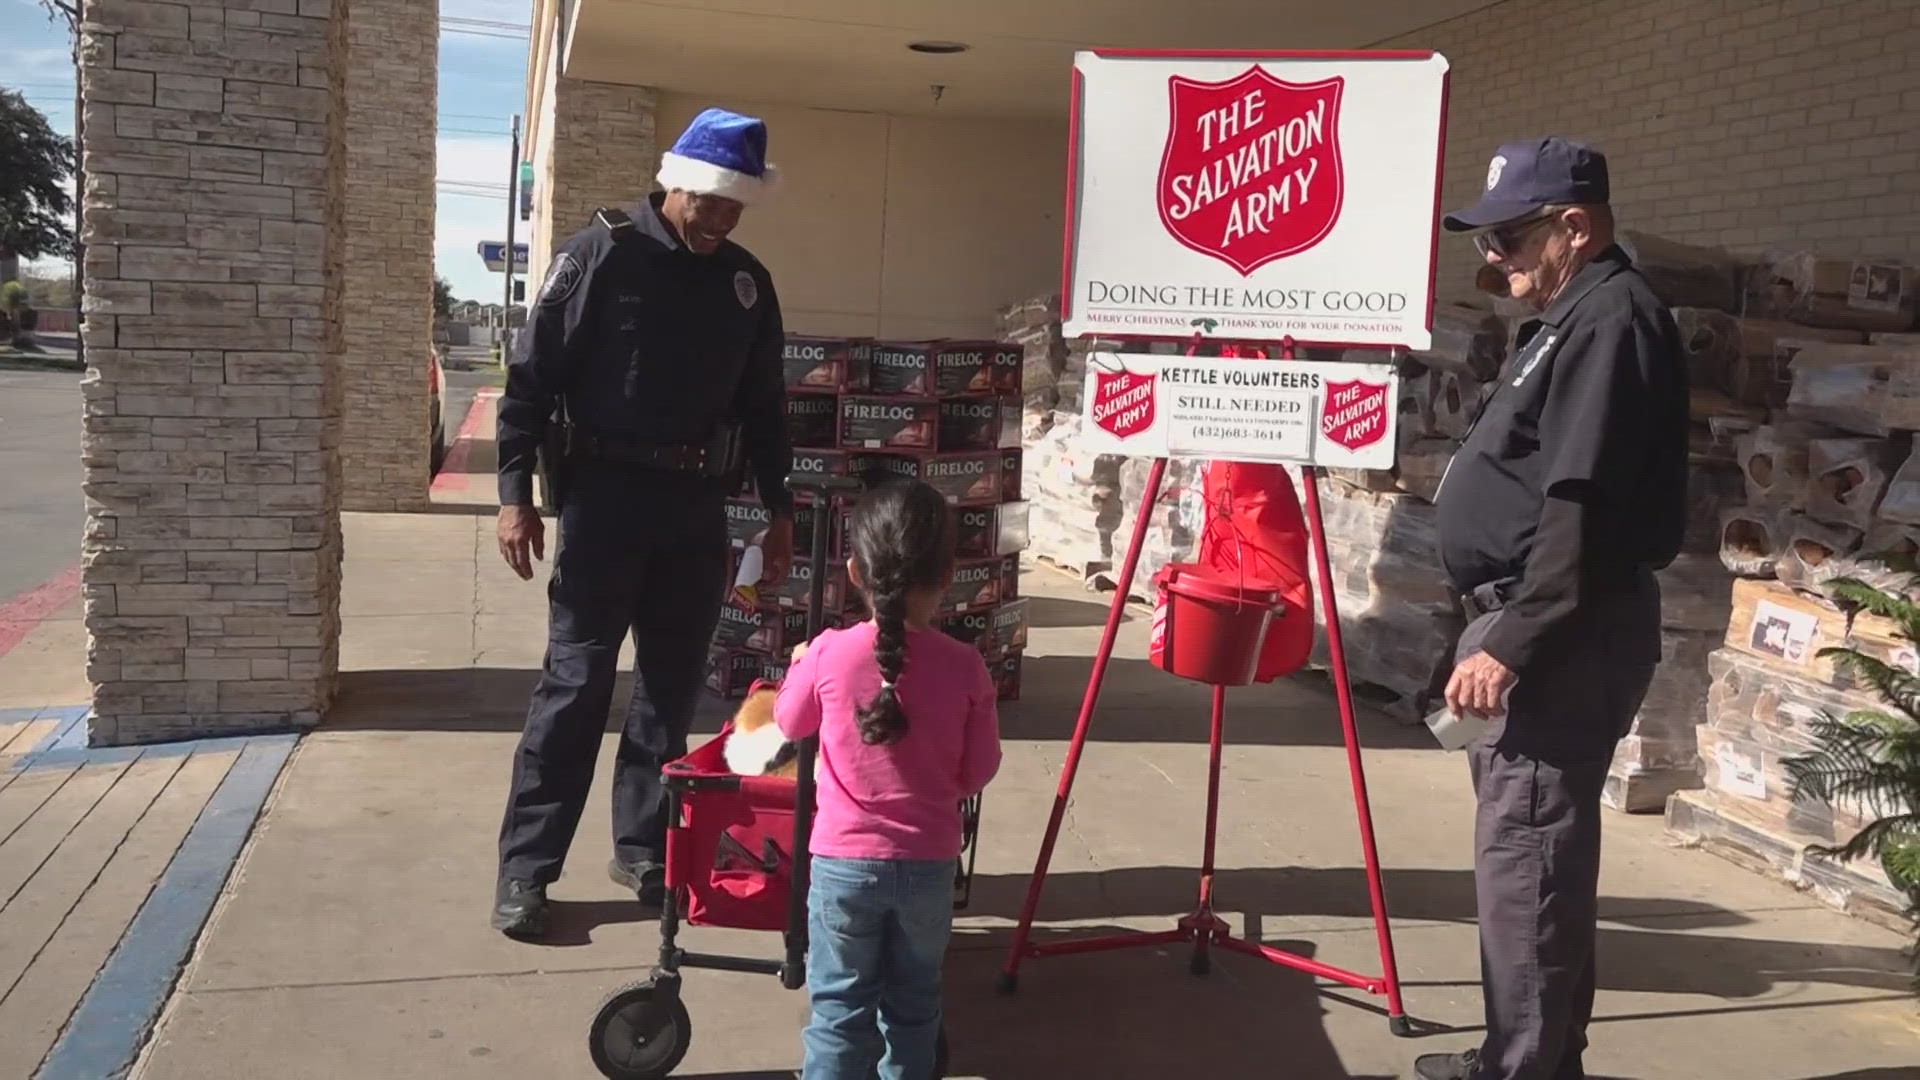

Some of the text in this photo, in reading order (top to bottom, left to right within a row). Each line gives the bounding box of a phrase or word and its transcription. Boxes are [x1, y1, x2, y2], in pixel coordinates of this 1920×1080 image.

[1196, 89, 1266, 153] THE
[1169, 99, 1325, 221] SALVATION
[1220, 157, 1319, 248] ARMY
[1088, 281, 1406, 312] DOING THE MOST GOOD
[1087, 313, 1187, 327] MERRY CHRISTMAS
[1220, 318, 1403, 333] THANK YOU FOR YOUR DONATION
[783, 345, 825, 360] ELOG
[873, 351, 926, 369] FIRELOG
[937, 352, 984, 367] FIRELOG
[1104, 374, 1130, 398] THE
[1161, 367, 1320, 389] KETTLE VOLUNTEERS
[1094, 379, 1152, 422] SALVATION
[1177, 395, 1301, 413] STILL NEEDED
[1333, 385, 1361, 409] THE
[844, 404, 914, 420] FIRELOG
[1114, 400, 1150, 431] ARMY
[1323, 389, 1383, 433] SALVATION
[1192, 425, 1283, 441] (432)683-3614
[1343, 410, 1381, 443] ARMY
[926, 460, 984, 477] FIRELOG
